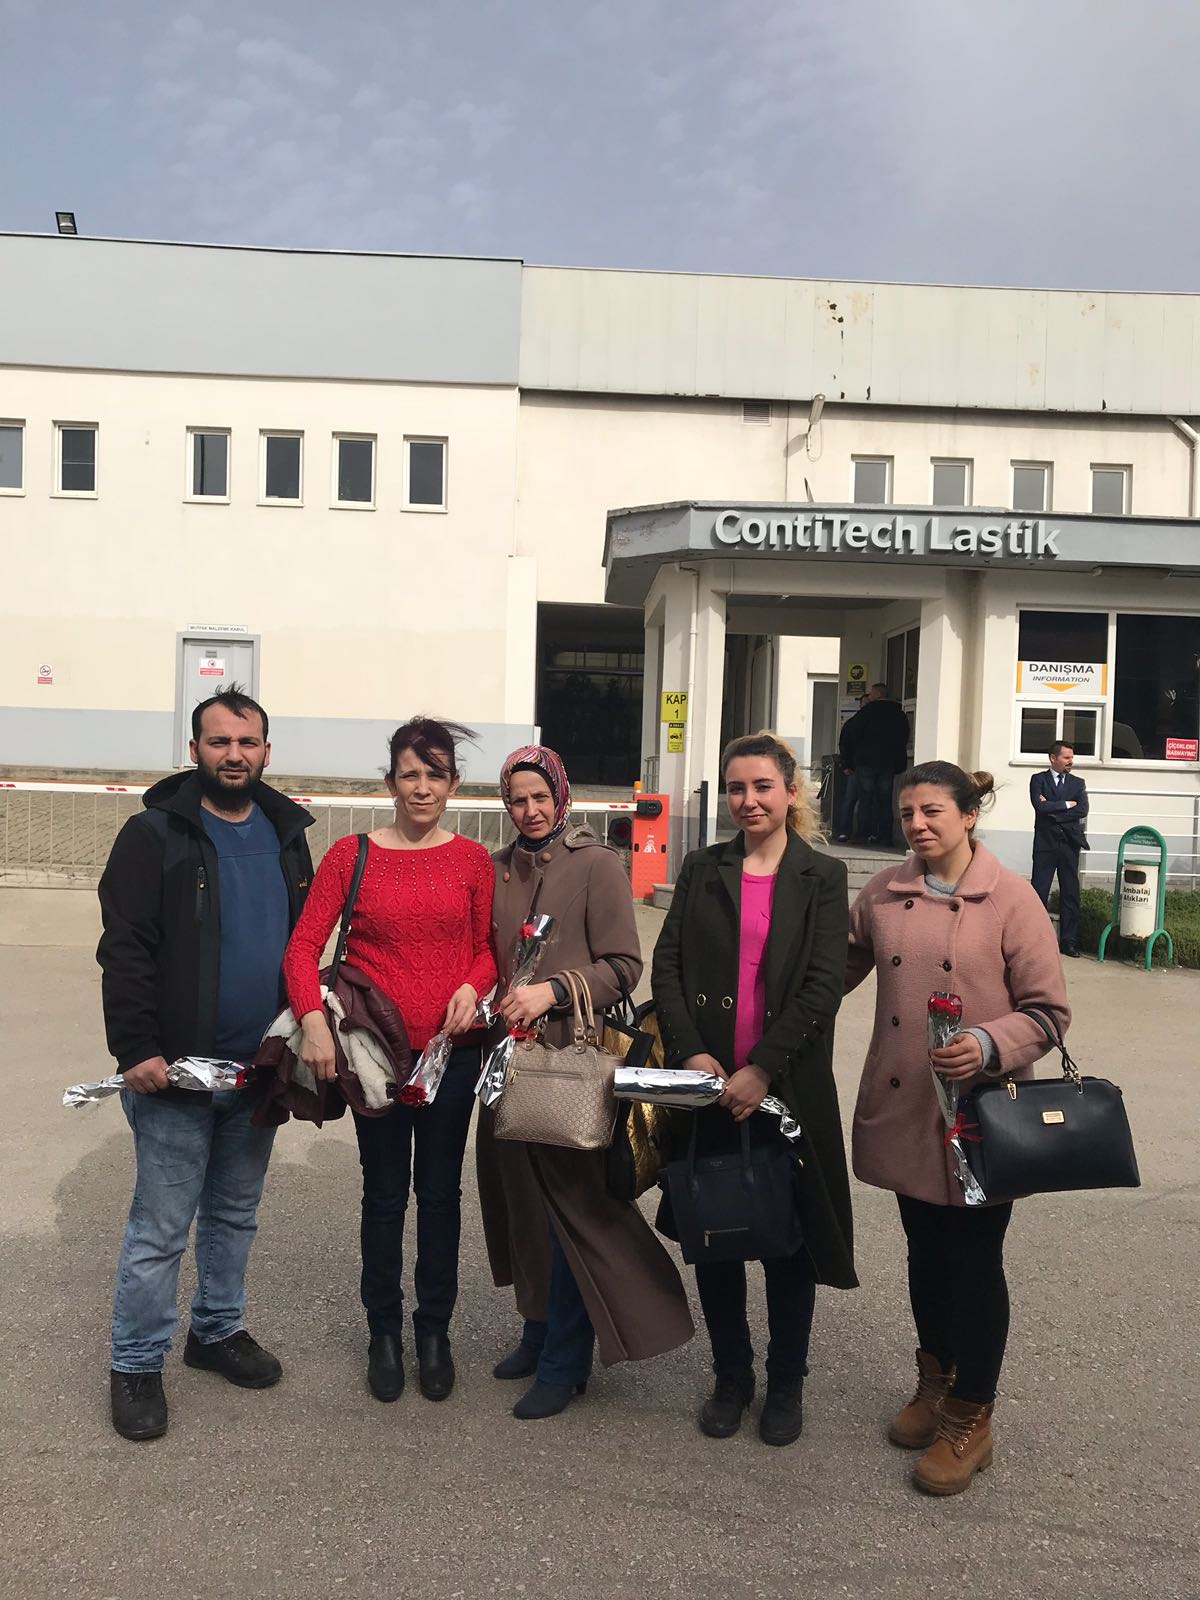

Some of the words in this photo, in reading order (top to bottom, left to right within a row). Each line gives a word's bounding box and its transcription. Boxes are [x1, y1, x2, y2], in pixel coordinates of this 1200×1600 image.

[714, 510, 918, 551] ContiTech
[930, 517, 1061, 555] Lastik
[1029, 663, 1095, 675] DANIŞMA
[666, 694, 688, 705] KAP
[674, 709, 679, 719] 1
